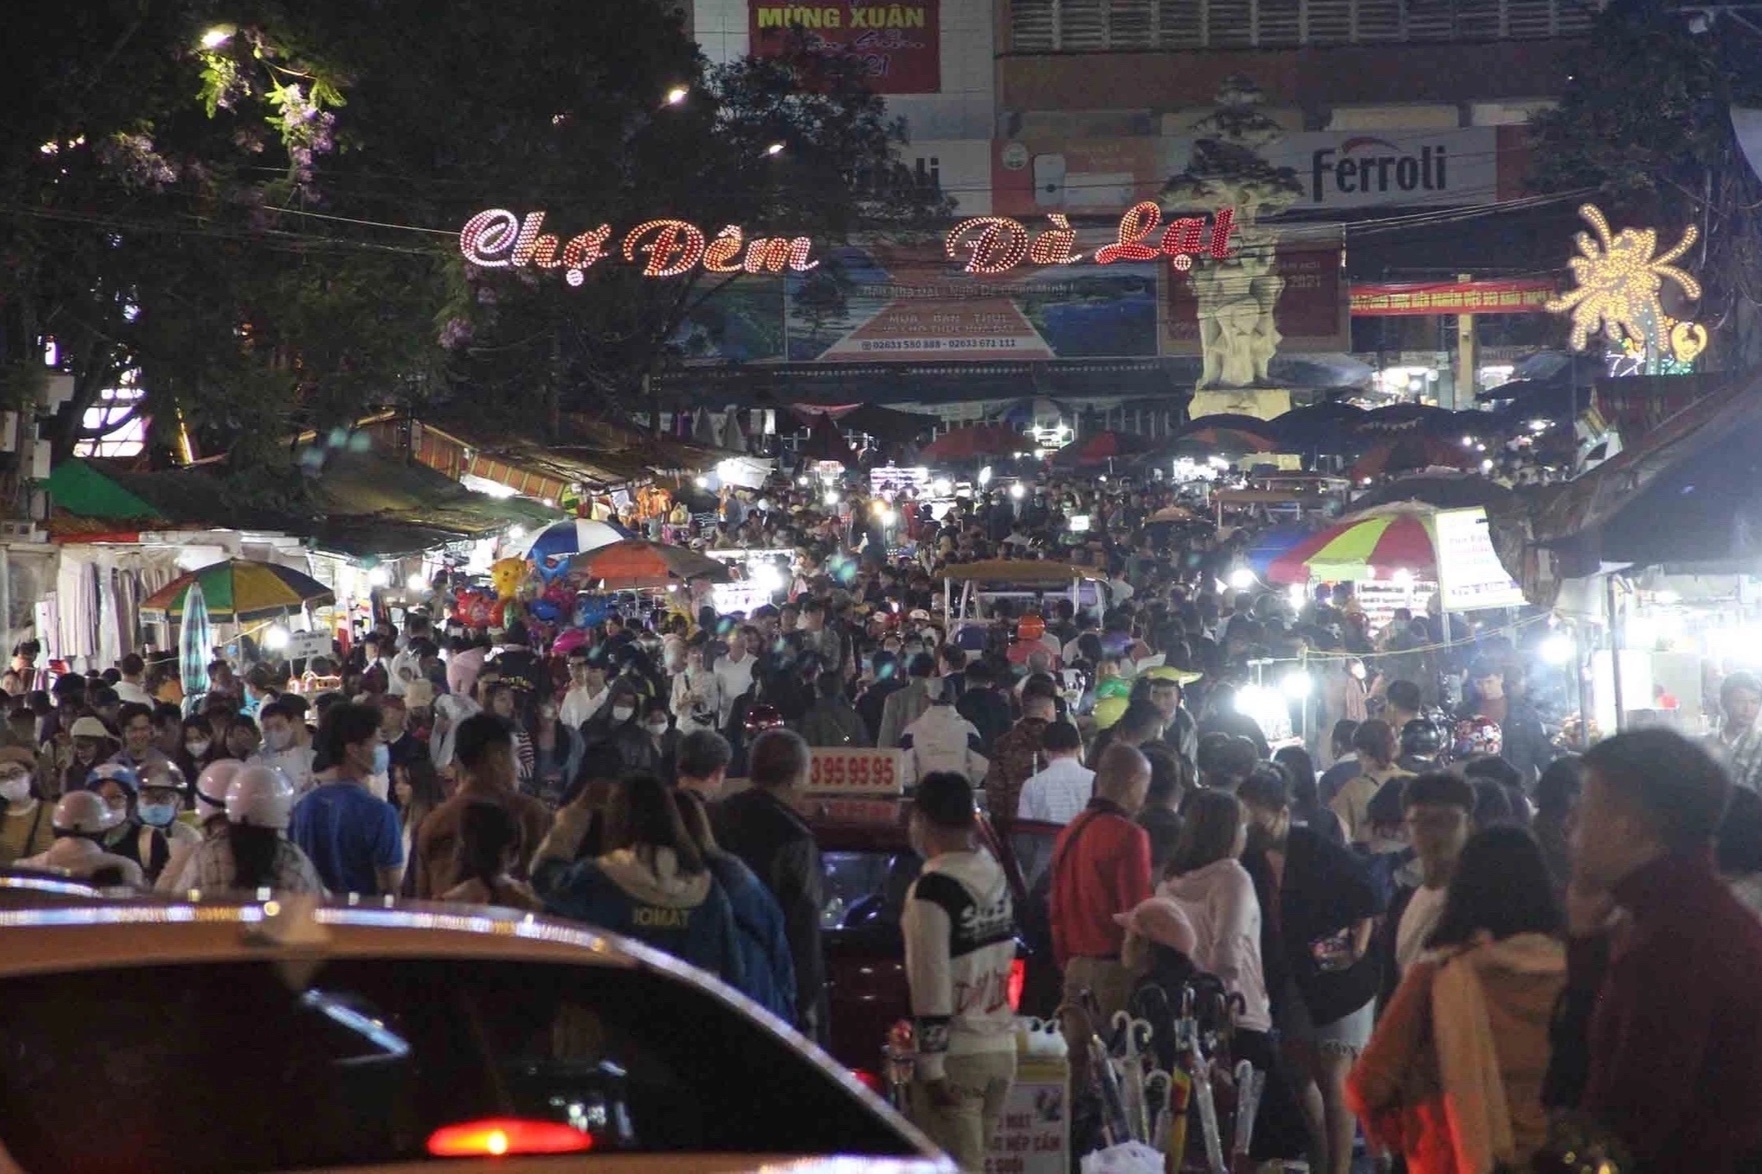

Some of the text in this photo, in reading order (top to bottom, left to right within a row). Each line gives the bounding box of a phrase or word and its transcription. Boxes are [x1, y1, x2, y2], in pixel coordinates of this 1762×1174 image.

[757, 3, 925, 29] MỪNG XUÂN
[460, 200, 1237, 287] Chợ Đêm Đà Lạt
